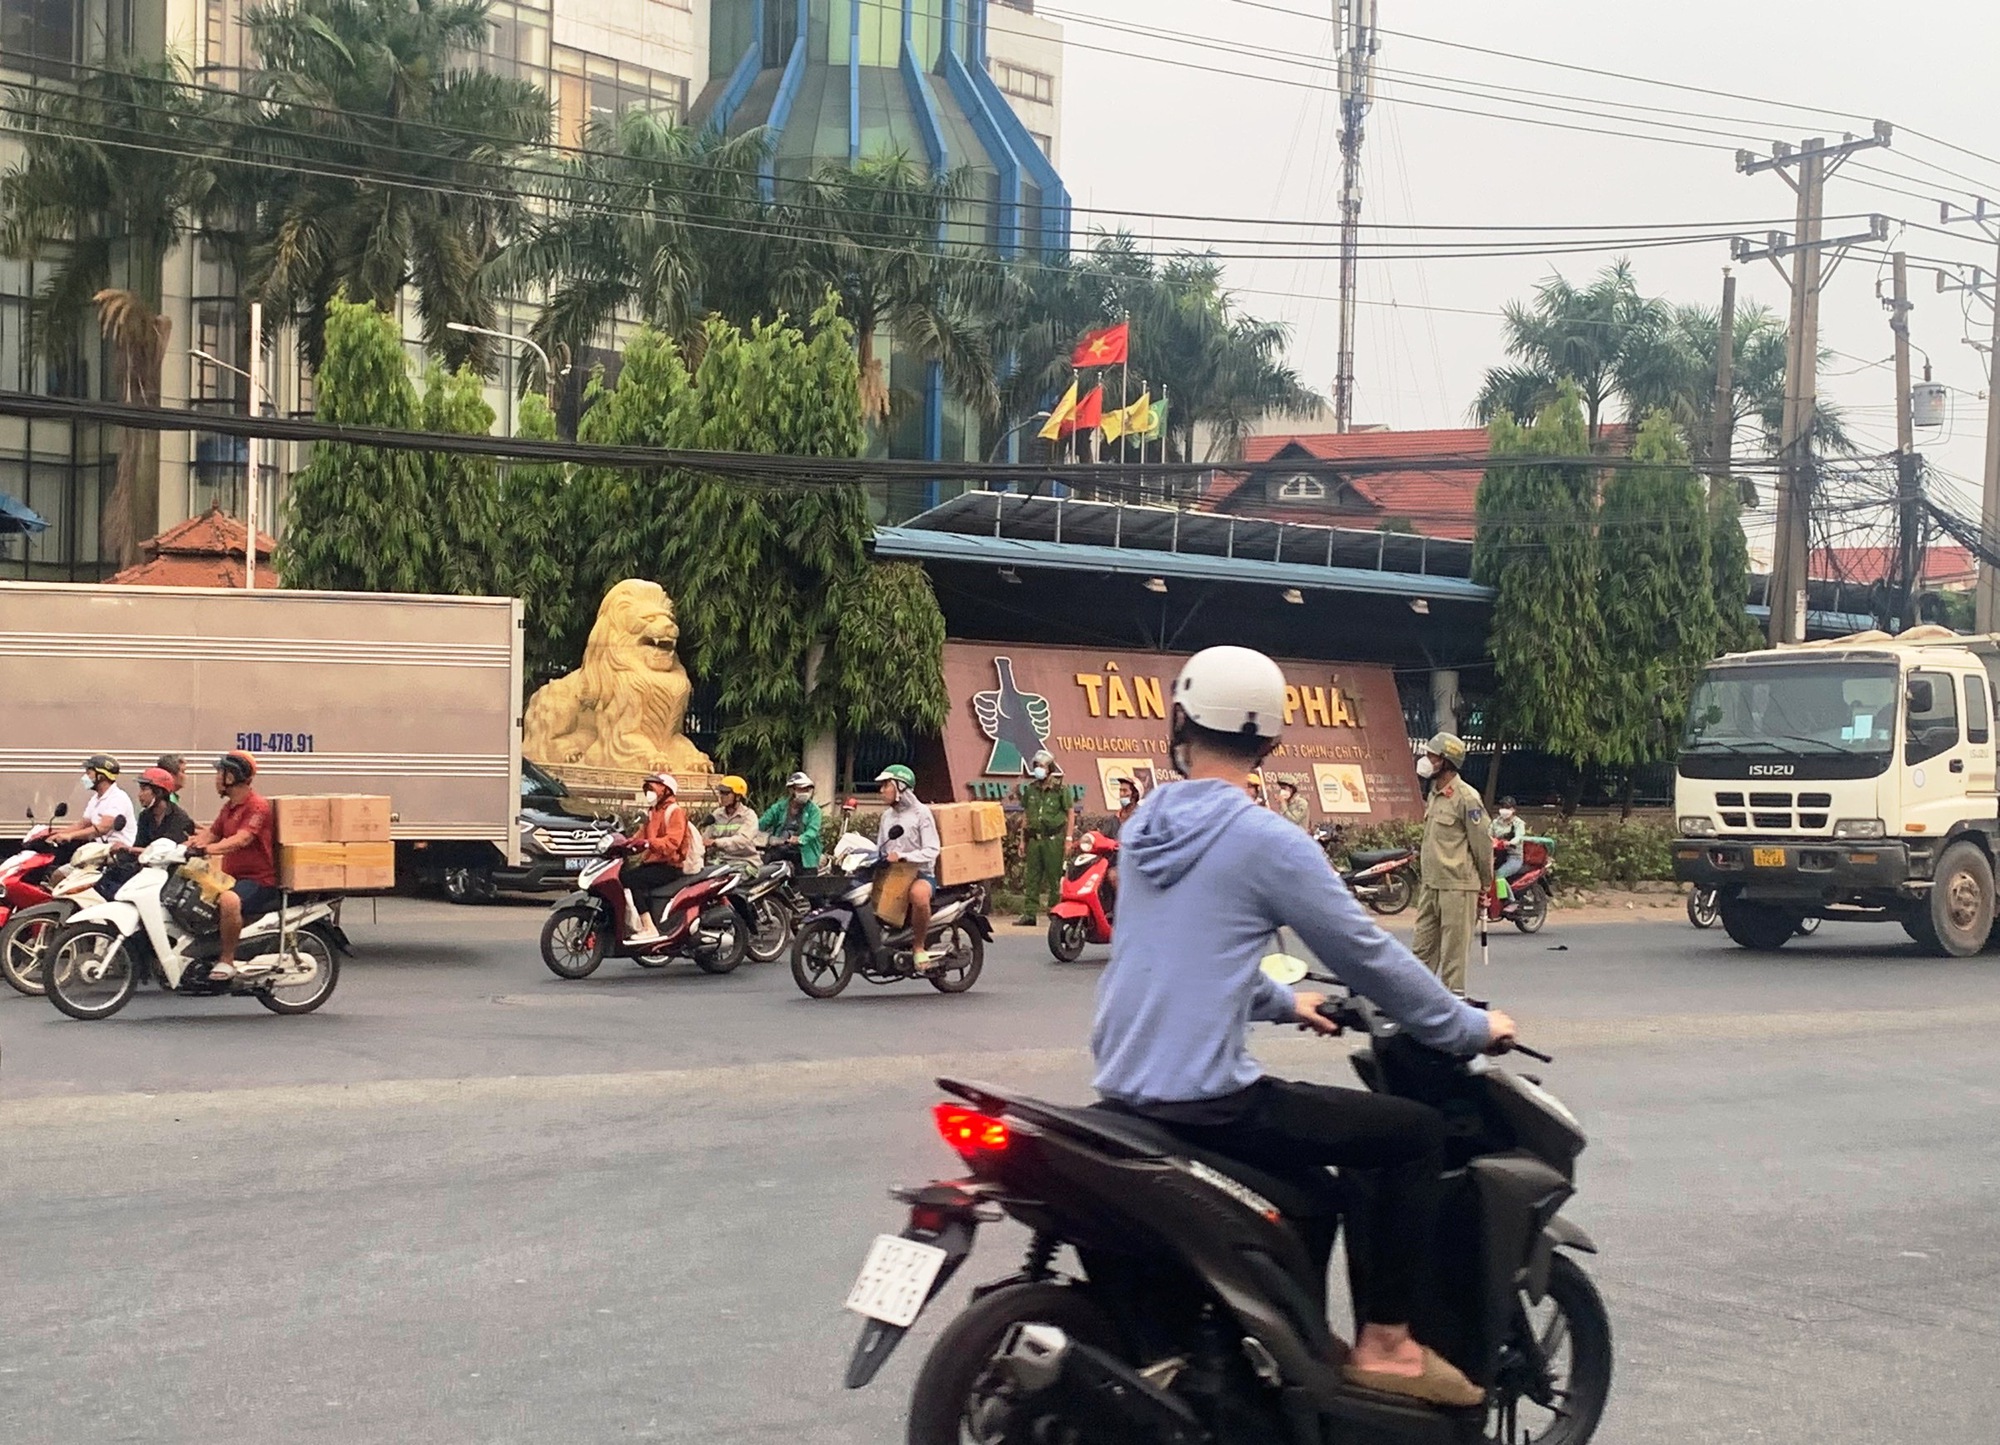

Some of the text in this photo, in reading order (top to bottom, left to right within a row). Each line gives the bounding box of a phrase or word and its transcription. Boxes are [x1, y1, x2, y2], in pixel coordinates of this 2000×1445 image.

[1076, 661, 1367, 727] TÂN PHÁT
[237, 732, 313, 753] 51D-478.91
[1073, 734, 1095, 752] HÀO
[1110, 735, 1140, 753] CÔNG
[1142, 739, 1156, 753] TY
[1264, 771, 1278, 783] ISO
[1749, 765, 1795, 775] ISUZU
[968, 782, 1010, 799] THP
